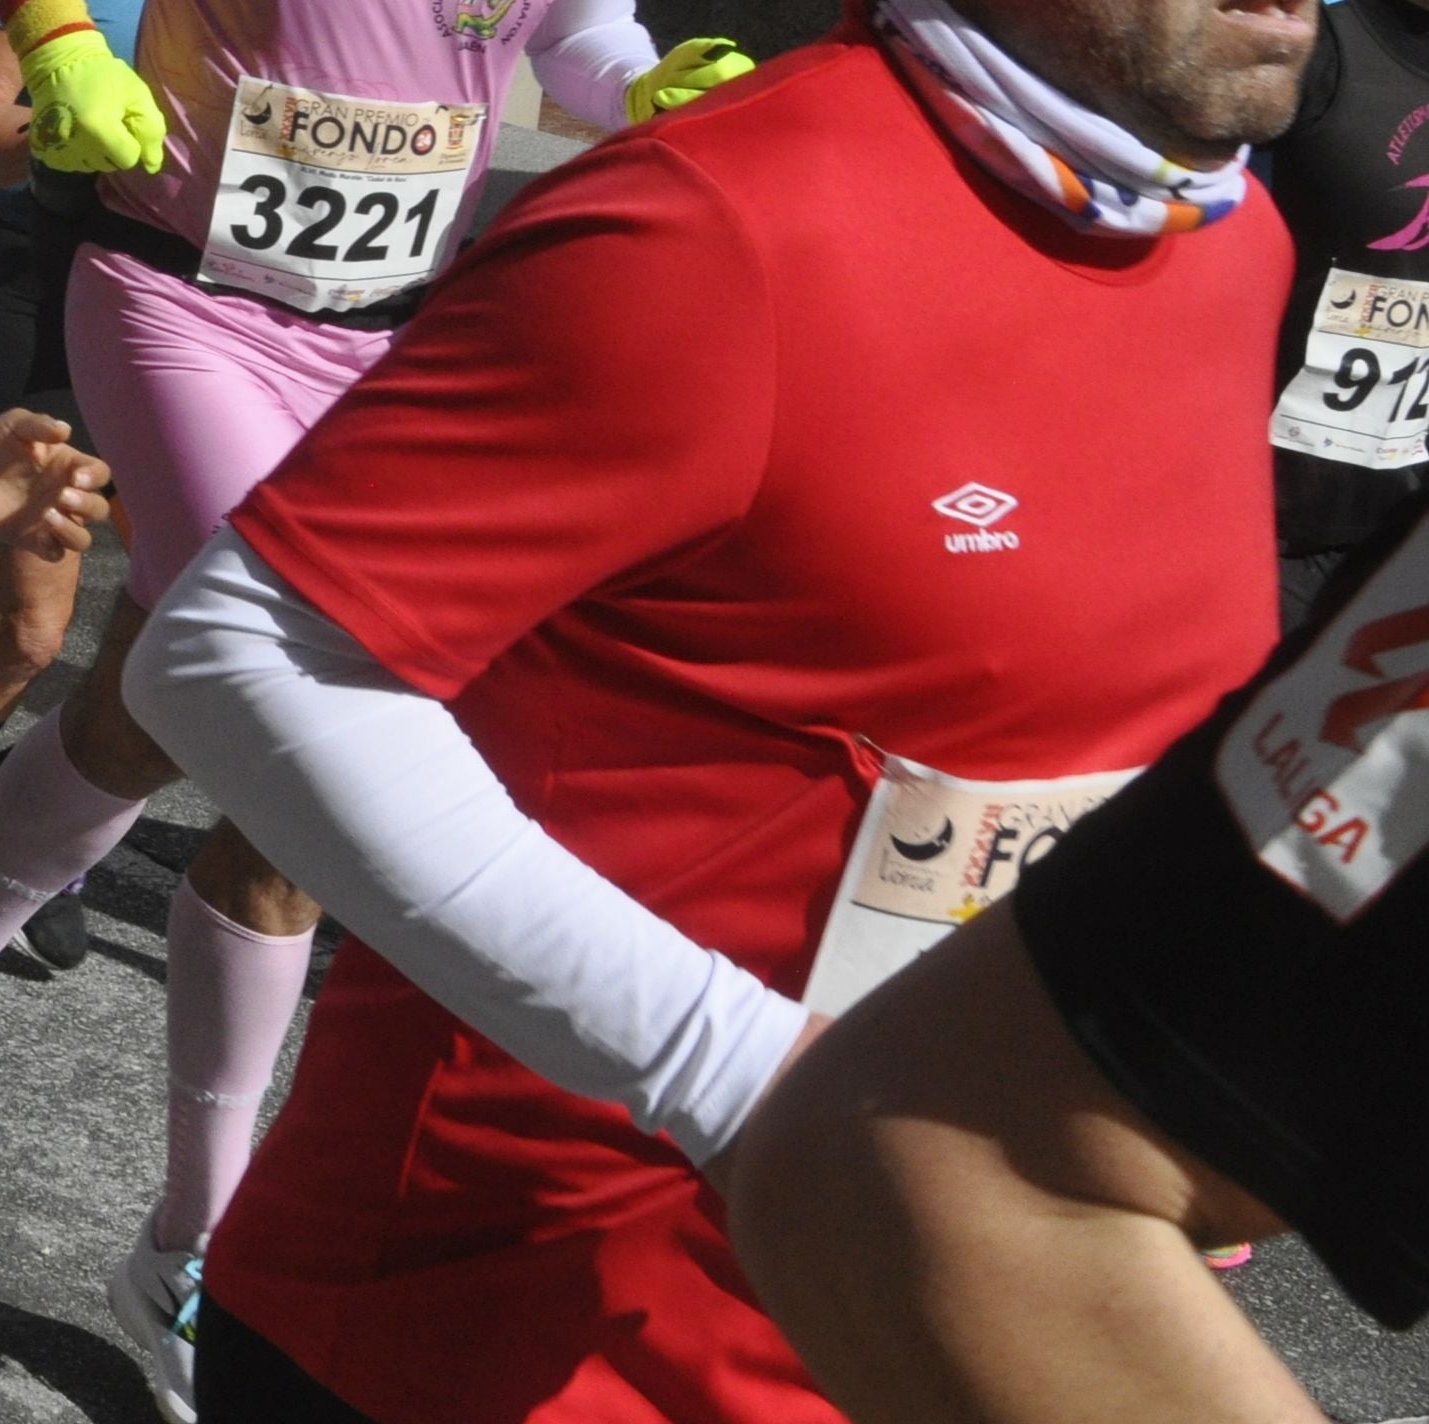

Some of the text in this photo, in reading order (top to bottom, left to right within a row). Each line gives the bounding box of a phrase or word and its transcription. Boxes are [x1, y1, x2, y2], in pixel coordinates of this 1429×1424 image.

[296, 99, 419, 128] GRAN PREMIO
[290, 111, 437, 156] FONDO
[230, 174, 440, 262] 3221
[943, 527, 1020, 554] umbro
